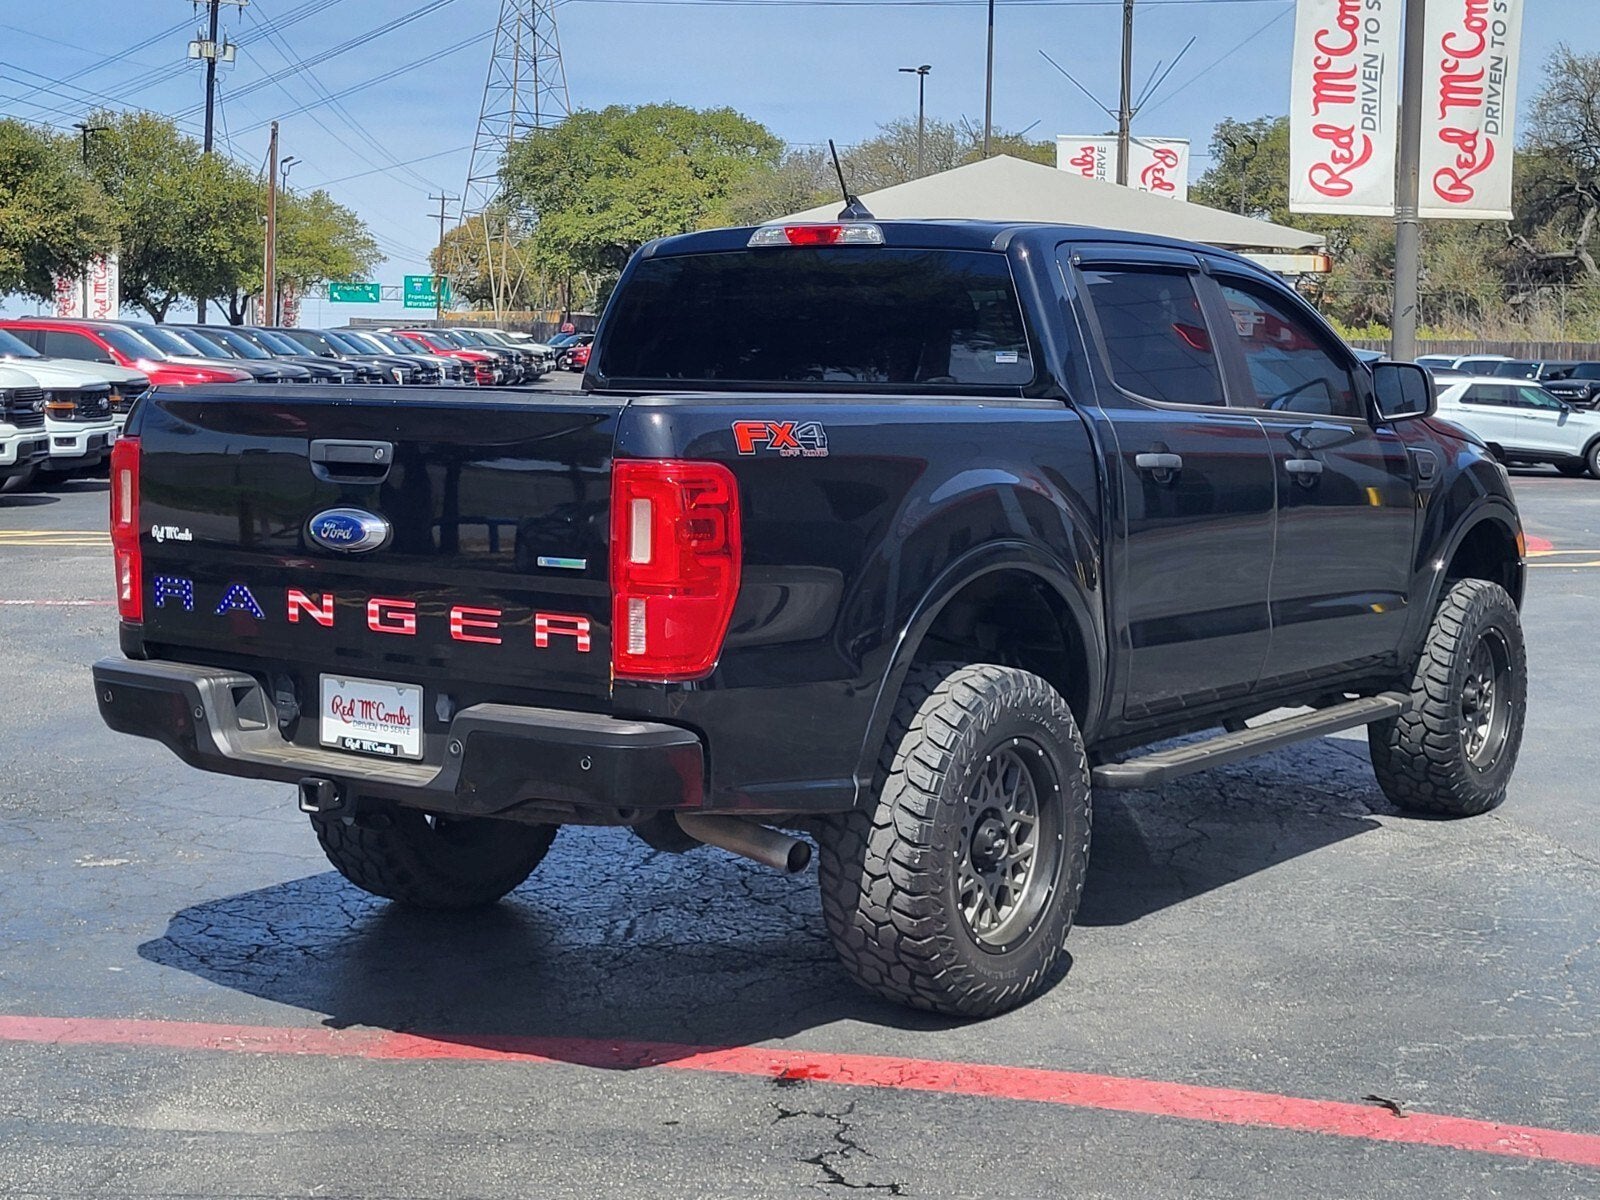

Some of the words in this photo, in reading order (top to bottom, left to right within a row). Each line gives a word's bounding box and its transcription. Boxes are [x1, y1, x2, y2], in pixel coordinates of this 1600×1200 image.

[1364, 18, 1381, 45] TO
[1491, 20, 1507, 48] TO
[1438, 0, 1489, 120] McCom
[1361, 53, 1379, 132] DRIVEN
[1485, 56, 1503, 135] DRIVEN
[1141, 148, 1178, 192] Red
[1308, 123, 1373, 197] Red
[1433, 127, 1494, 203] Red
[732, 420, 828, 455] FX4
[321, 522, 353, 540] Ford
[154, 575, 591, 653] RANGER
[332, 695, 355, 724] Red
[358, 699, 411, 726] McCombs
[352, 719, 378, 732] DRIVEN
[380, 723, 389, 732] TO
[390, 726, 411, 736] SERVE
